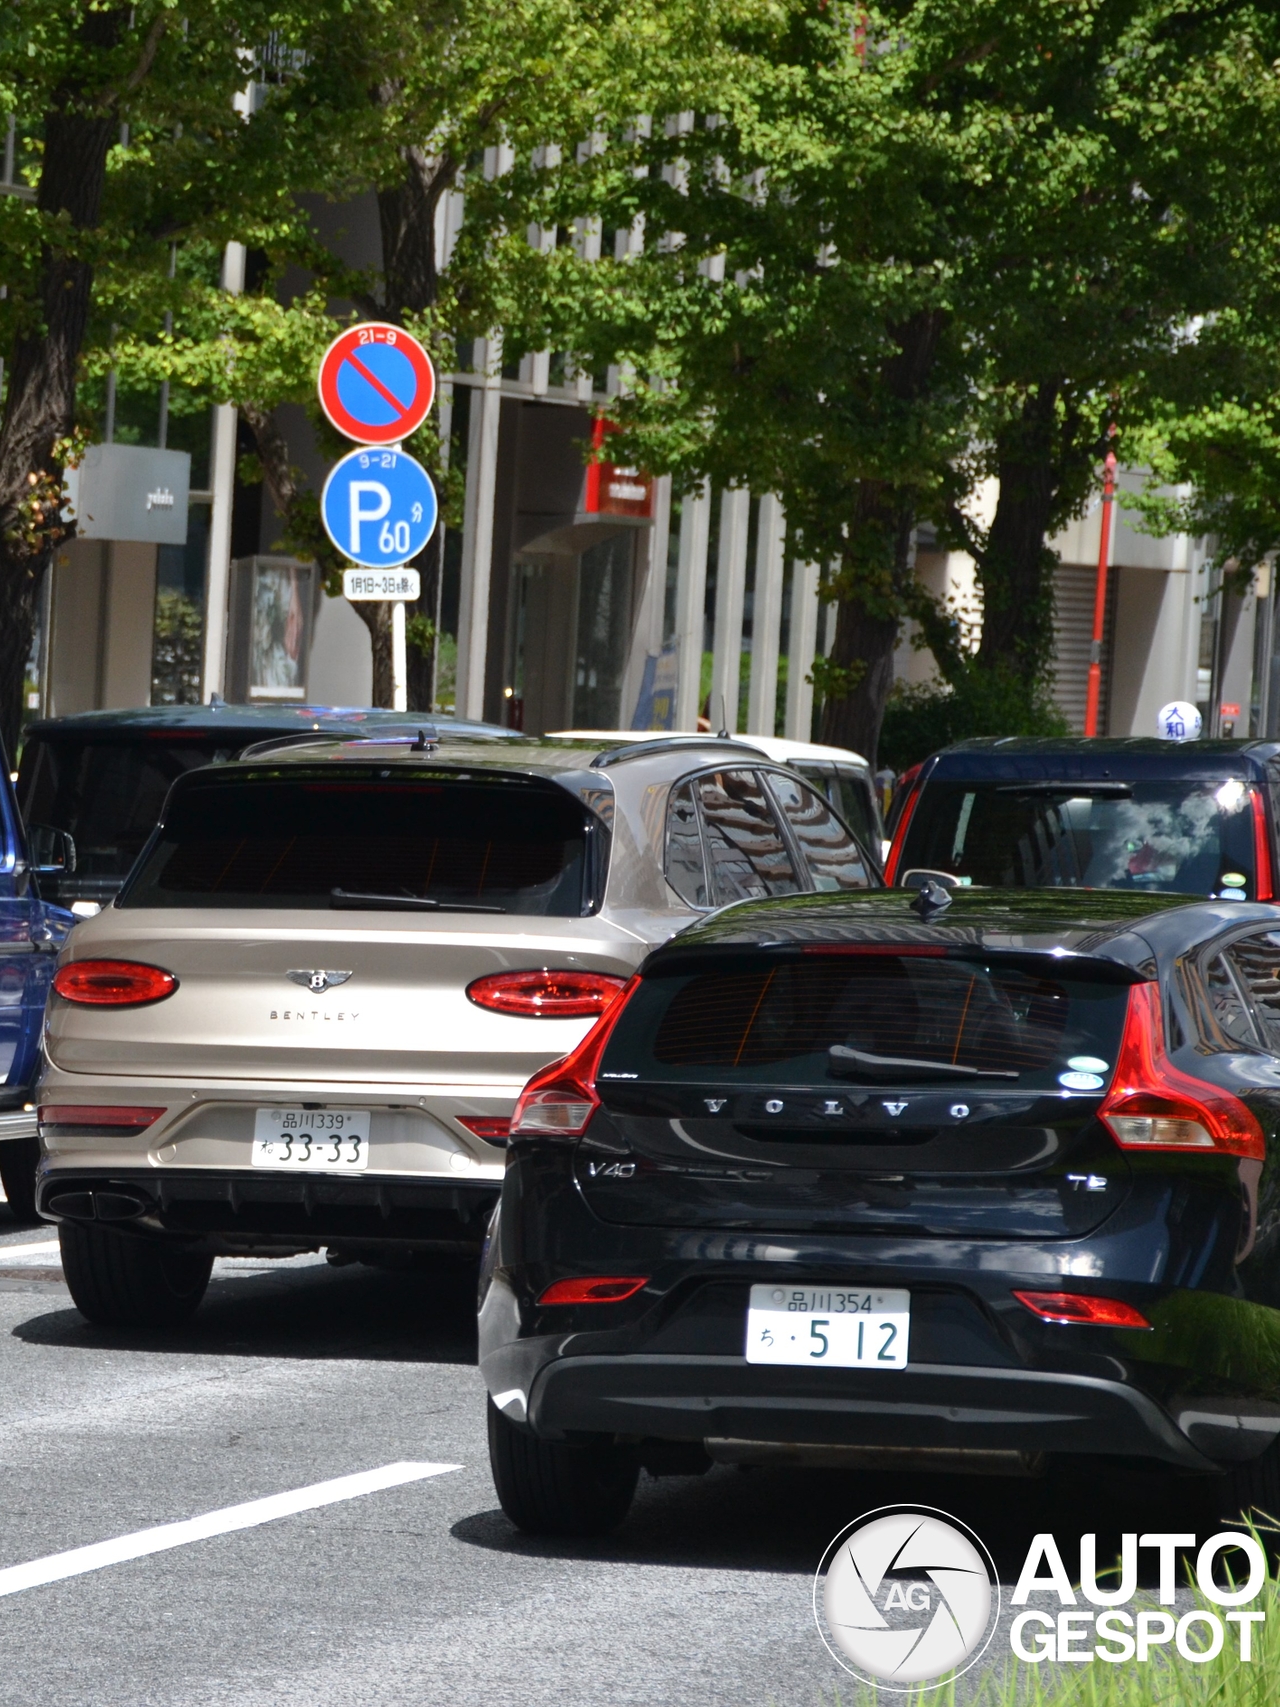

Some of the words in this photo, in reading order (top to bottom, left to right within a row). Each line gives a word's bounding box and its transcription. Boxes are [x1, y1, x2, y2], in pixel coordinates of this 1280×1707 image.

[358, 329, 397, 345] 21-9
[358, 453, 397, 469] 9-21
[349, 480, 392, 554] P
[378, 520, 411, 554] 60
[411, 501, 424, 523] 分
[1165, 706, 1186, 738] 大和
[270, 1010, 359, 1021] BENTLEY
[704, 1098, 970, 1119] VOLVO
[282, 1113, 344, 1129] 品川339
[279, 1133, 362, 1163] 33-33
[589, 1162, 636, 1178] V40
[788, 1291, 873, 1314] 品川354
